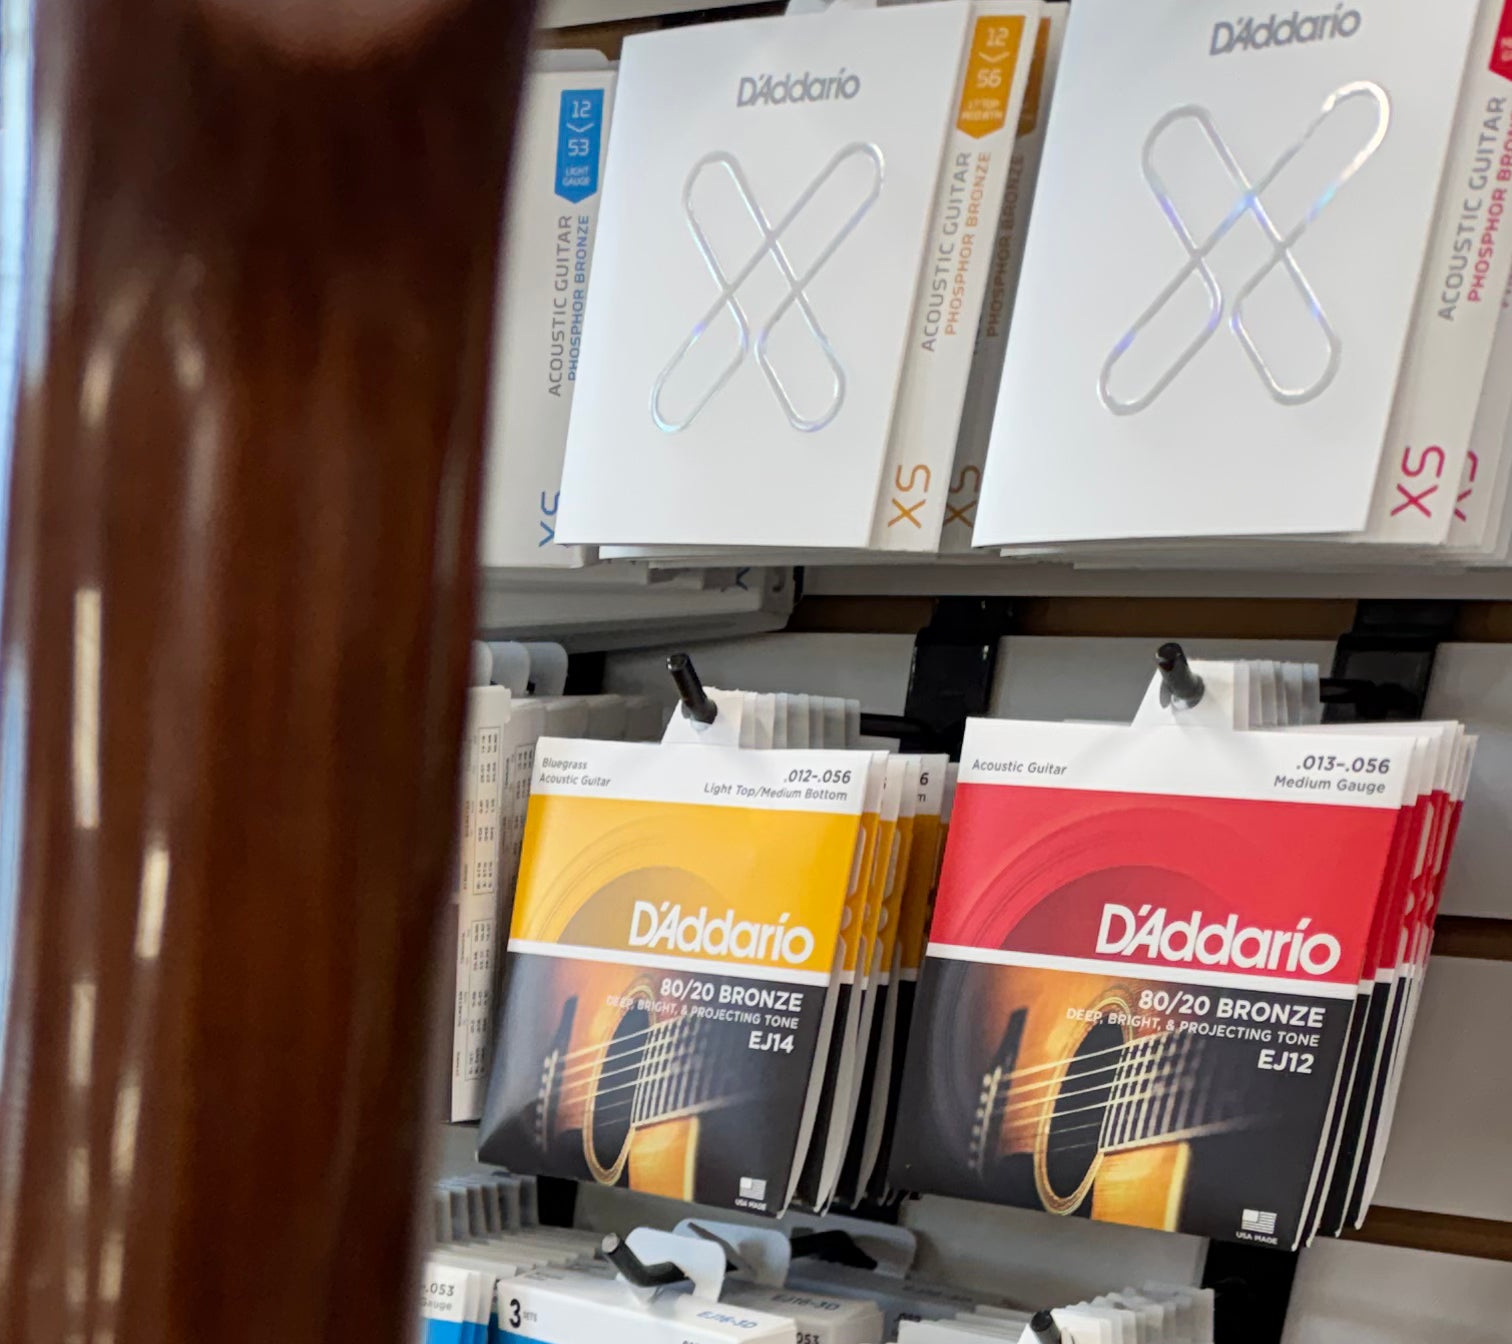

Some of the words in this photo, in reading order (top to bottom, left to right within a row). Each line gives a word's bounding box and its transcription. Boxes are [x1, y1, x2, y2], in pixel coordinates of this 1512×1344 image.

[1438, 207, 1483, 322] ACOUSTIC
[1469, 97, 1507, 200] GUITAR
[921, 243, 959, 352] ACOUSTIC
[943, 152, 971, 236] GUITAR
[945, 233, 975, 336] PHOSPHOR
[965, 151, 991, 229] BRONZE
[1391, 445, 1444, 518] XS
[887, 464, 931, 529] XS
[945, 464, 980, 528] XS
[542, 758, 588, 771] Bluegrass
[784, 769, 851, 785] .012-.056
[972, 759, 1024, 774] Acoustic
[1027, 763, 1067, 777] Guitar
[1296, 755, 1390, 776] .013-.056
[540, 773, 578, 785] Acoustic
[580, 775, 611, 787] Guitar
[704, 783, 731, 796] Light
[735, 784, 802, 800] Top/Medium
[805, 789, 848, 801] Bottom
[1274, 775, 1331, 793] Medium
[1336, 779, 1386, 796] Gauge
[661, 979, 715, 1001] 80/20
[720, 987, 804, 1012] BRONZE
[1138, 990, 1211, 1015] 80/20
[1216, 998, 1326, 1028] BRONZE
[691, 1006, 761, 1026] PROJECTING
[765, 1016, 799, 1030] TONE
[1066, 1008, 1104, 1025] DEEP,
[1108, 1012, 1162, 1031] BRIGHT,
[1180, 1020, 1272, 1045] PROJECTING
[1277, 1031, 1320, 1048] TONE
[749, 1030, 794, 1054] EJ14
[1258, 1049, 1315, 1074] EJ12
[509, 1299, 521, 1329] 3
